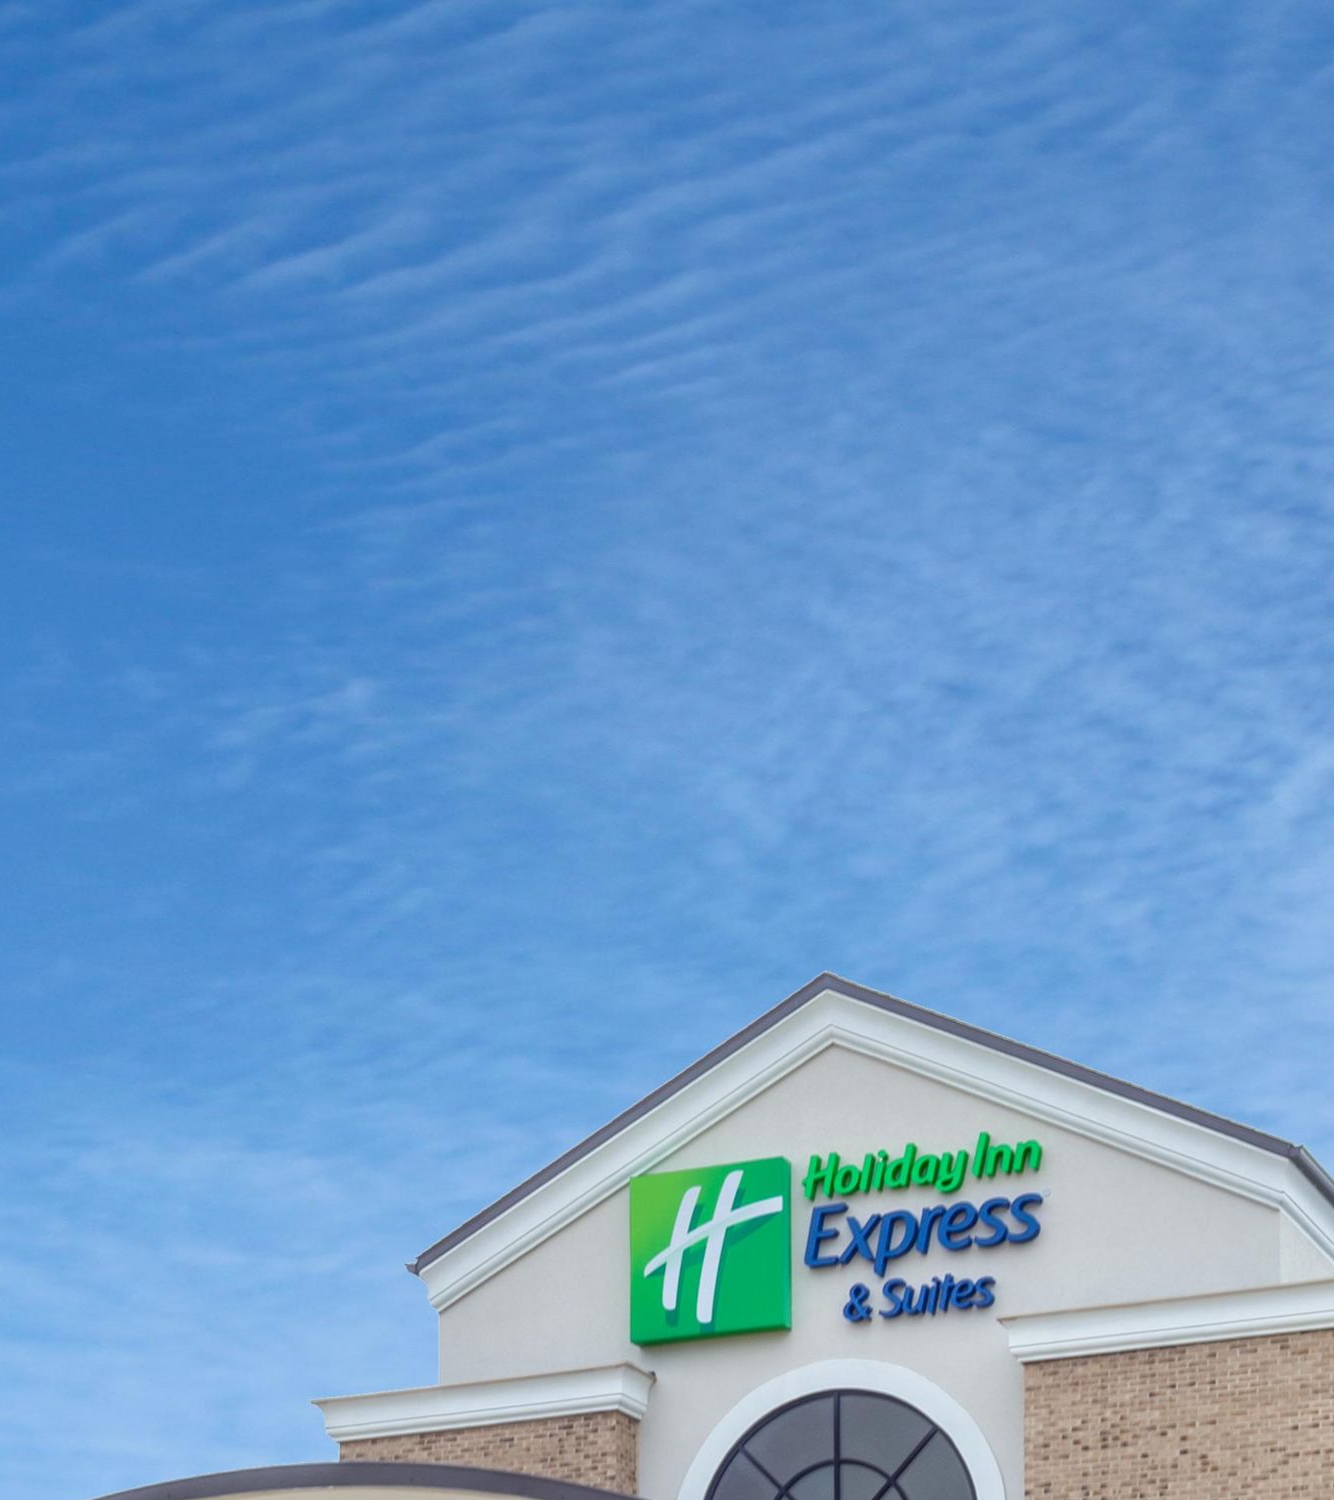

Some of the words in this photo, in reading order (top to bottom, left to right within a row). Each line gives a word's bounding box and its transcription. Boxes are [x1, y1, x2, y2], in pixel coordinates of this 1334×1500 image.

[803, 1142, 968, 1200] Holiday
[971, 1131, 1043, 1179] Inn
[804, 1192, 1043, 1277] Express
[843, 1282, 873, 1323] &
[879, 1273, 997, 1319] Suites
